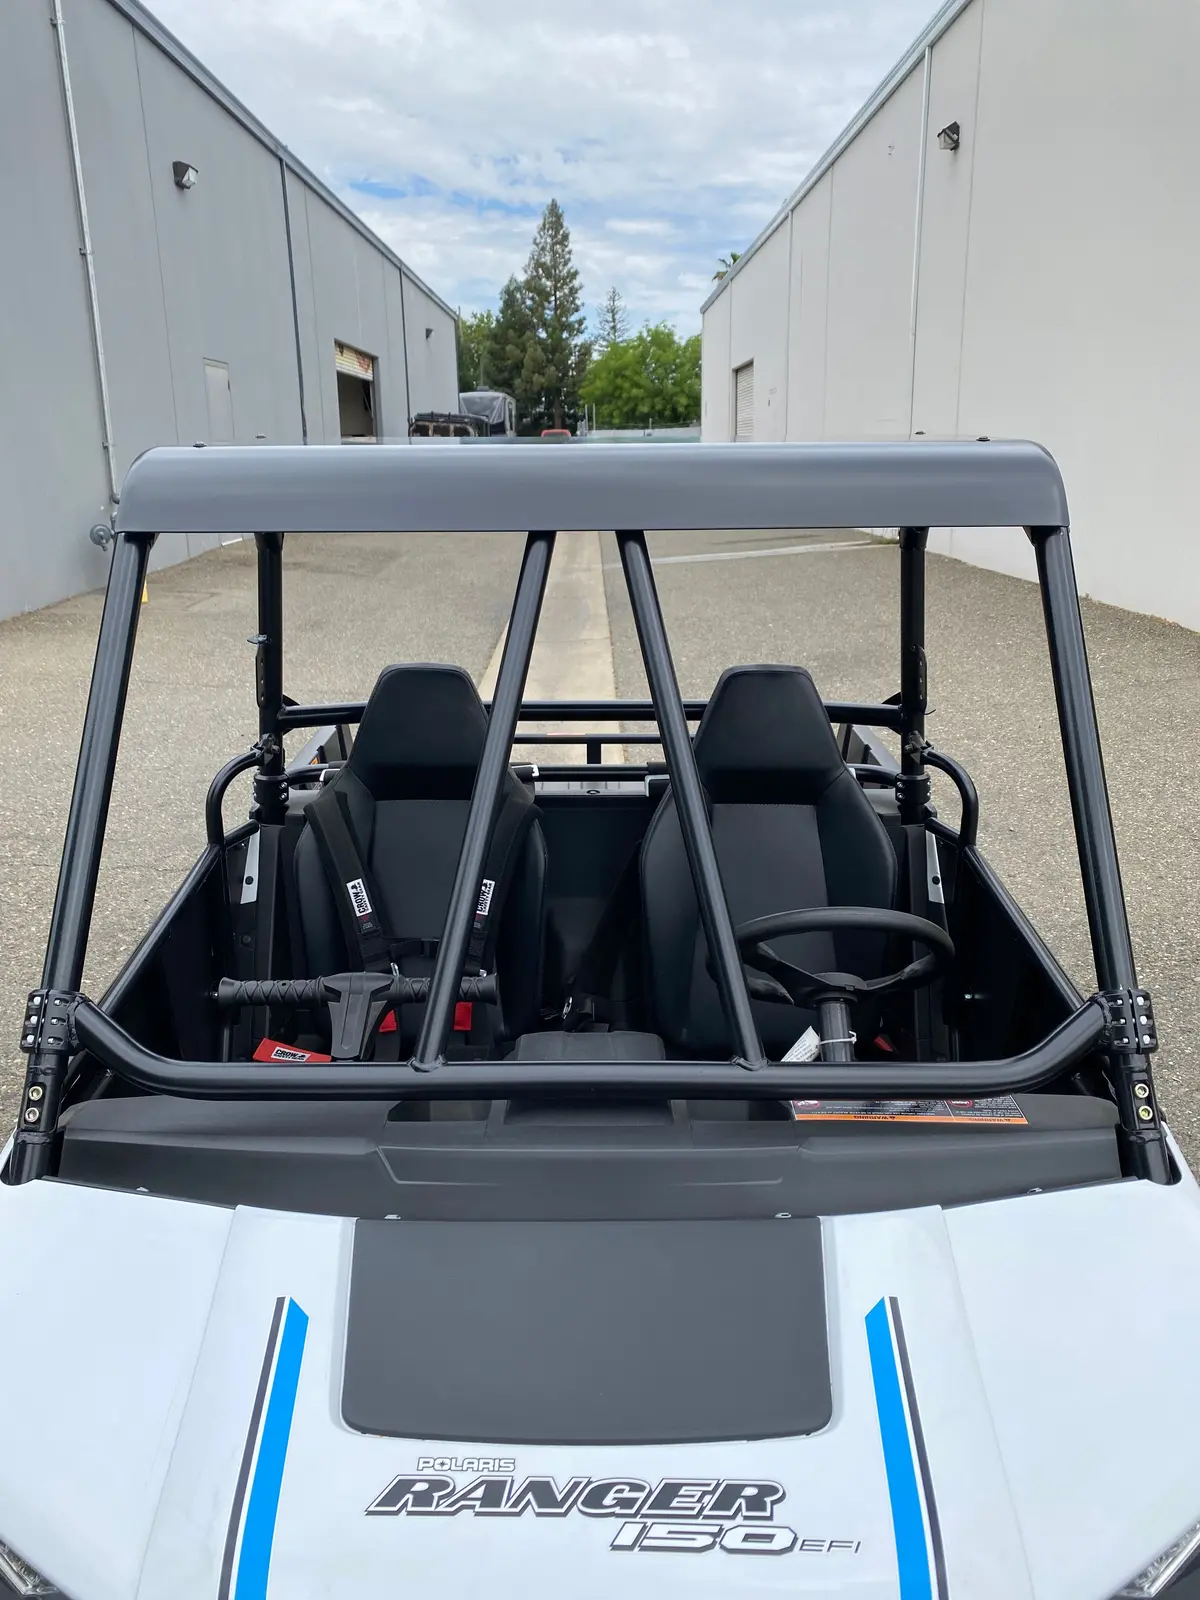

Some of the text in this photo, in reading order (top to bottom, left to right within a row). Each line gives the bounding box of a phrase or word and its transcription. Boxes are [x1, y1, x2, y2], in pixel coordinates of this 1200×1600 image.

[352, 891, 366, 914] CROW
[276, 1049, 299, 1058] CROW
[416, 1456, 516, 1472] POLARIS
[364, 1473, 787, 1521] RANGER
[609, 1521, 862, 1556] 150 EFI
